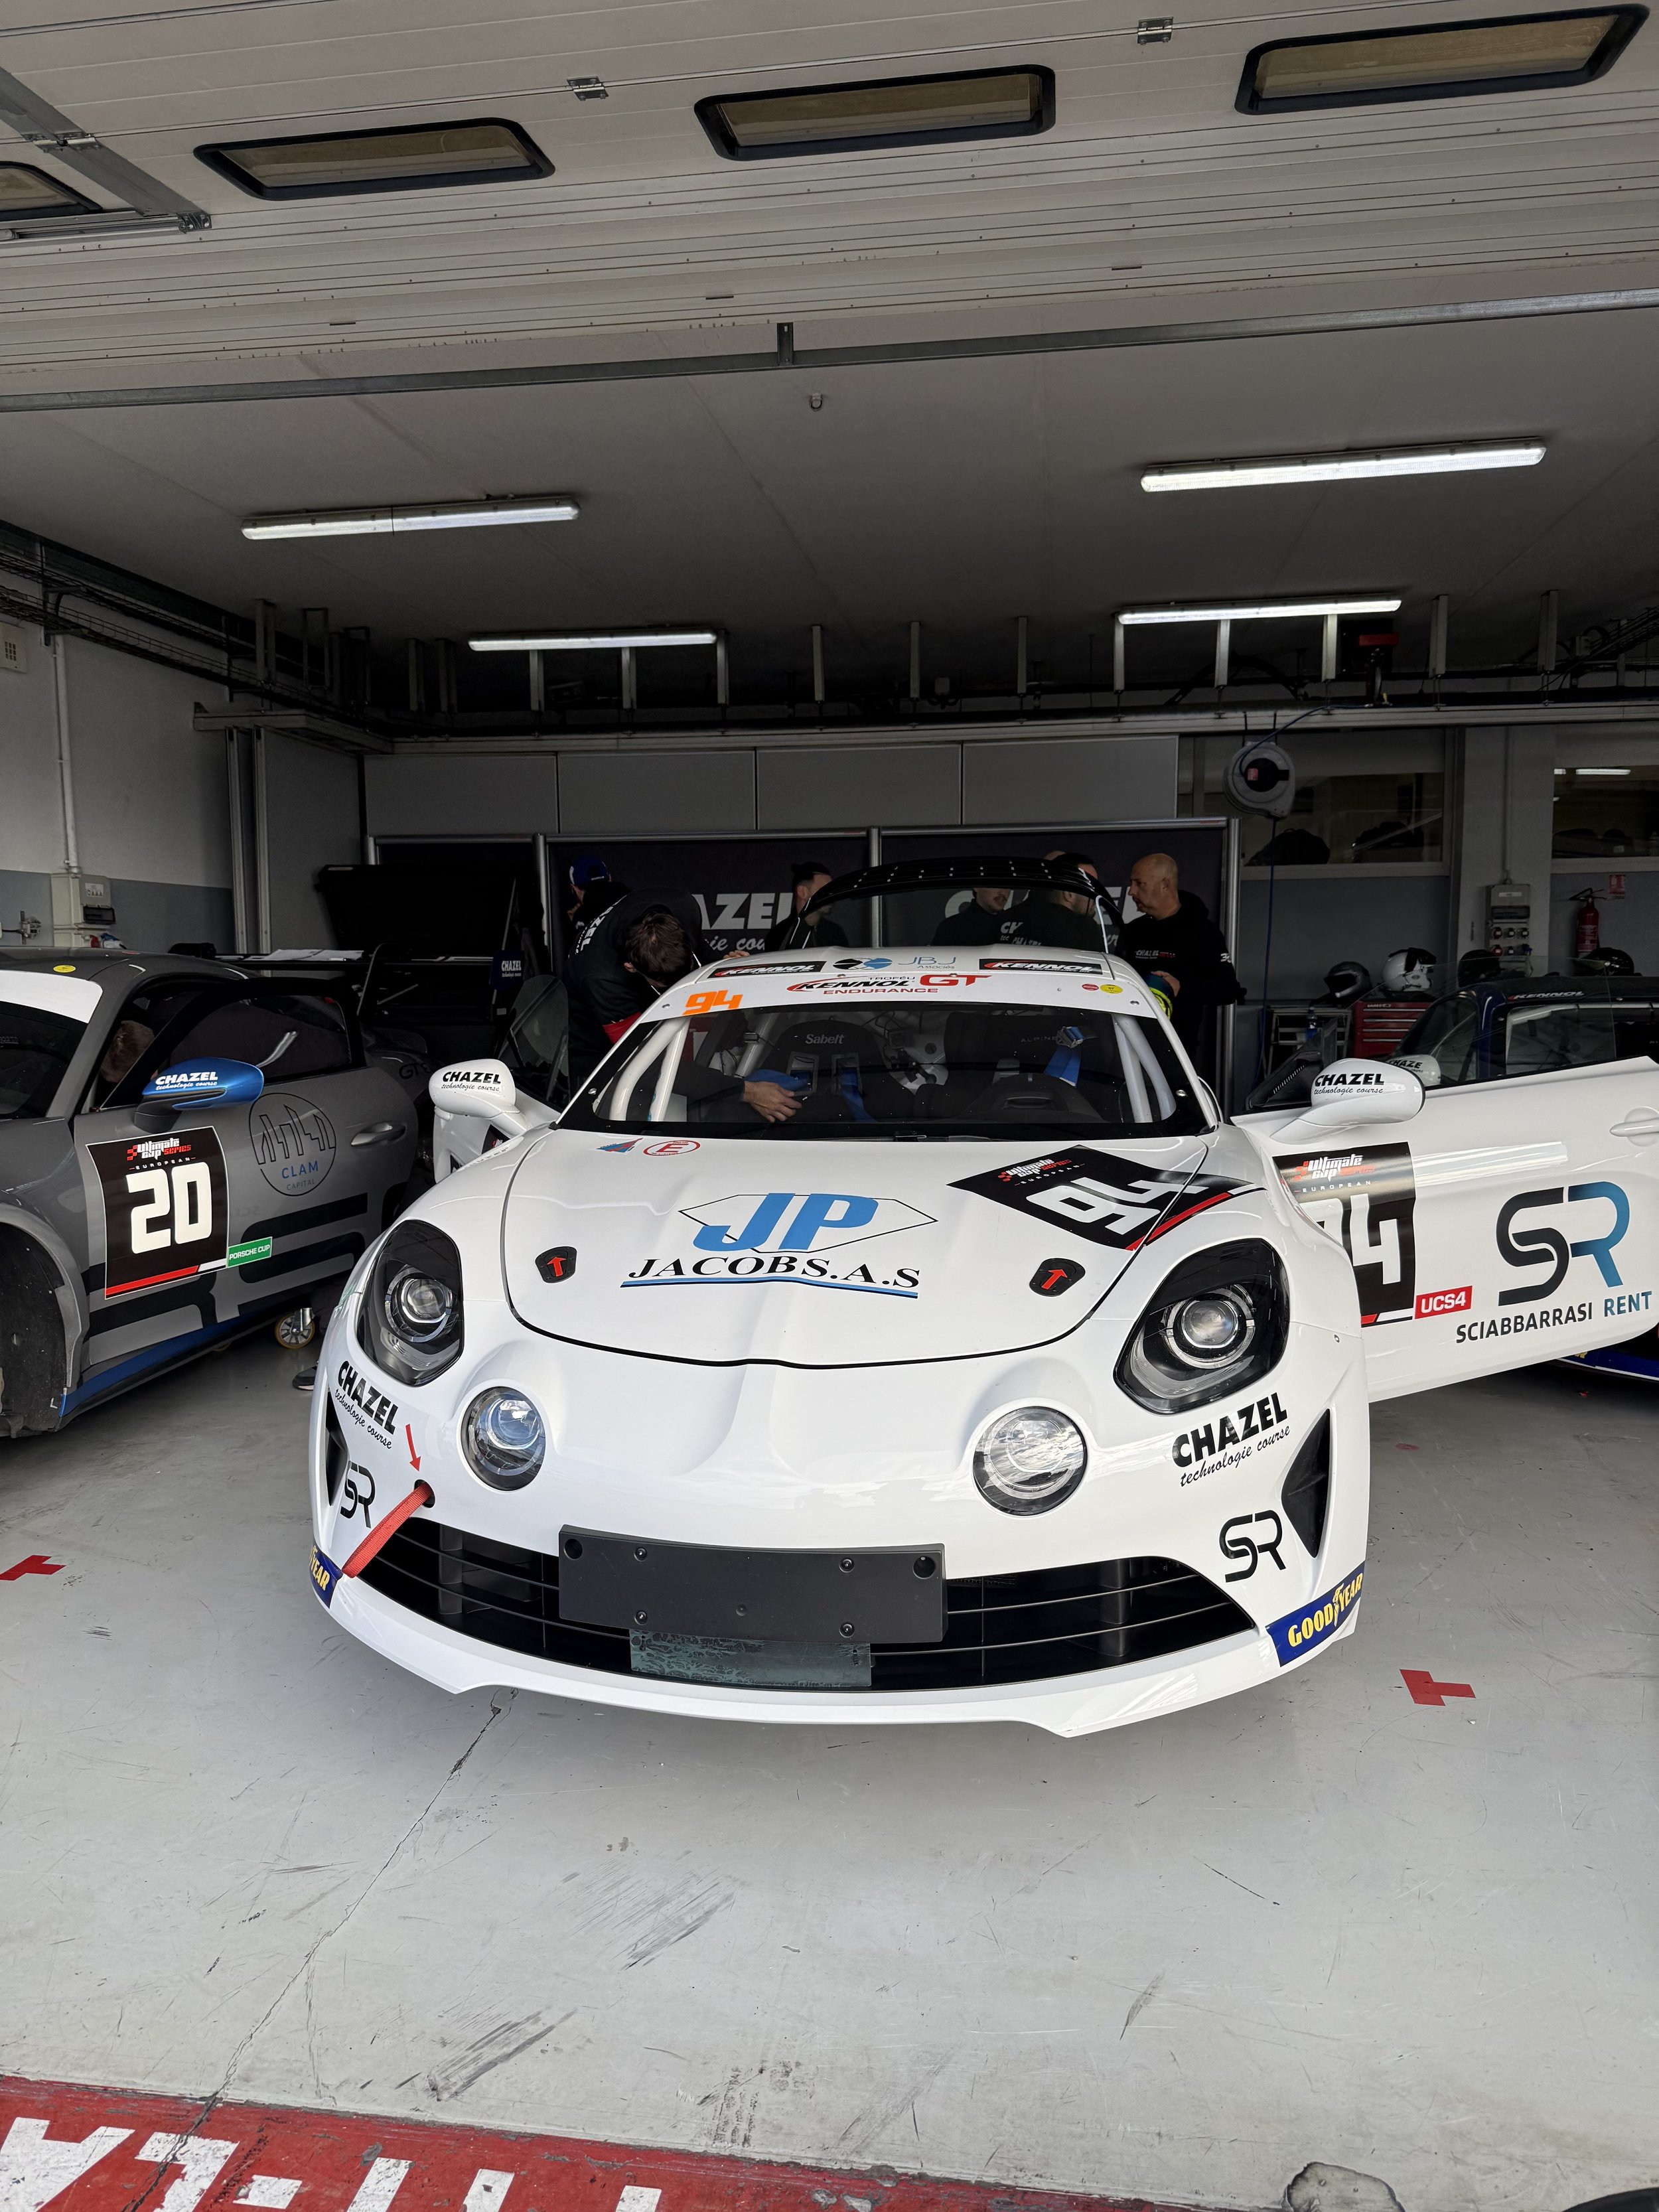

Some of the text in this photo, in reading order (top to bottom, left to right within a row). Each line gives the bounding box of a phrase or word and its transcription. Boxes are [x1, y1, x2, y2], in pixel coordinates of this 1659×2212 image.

[720, 964, 816, 975] KENNOL
[898, 956, 957, 966] JBJ
[991, 962, 1094, 972] KENNOL
[798, 974, 993, 990] KENNOL GT
[682, 989, 744, 1017] 94
[805, 1033, 845, 1044] Sabelt
[155, 1071, 218, 1085] CHAZEL
[442, 1071, 501, 1084] CHAZEL
[1315, 1073, 1385, 1086] CHAZEL
[155, 1082, 194, 1091] technologie
[441, 1082, 476, 1091] technologie
[1314, 1086, 1354, 1096] technologie
[135, 1157, 190, 1170] EUROPEAN
[281, 1160, 319, 1179] CLAM
[286, 1179, 316, 1191] CAPITAL
[1302, 1180, 1372, 1193] EUROPEAN
[125, 1161, 212, 1254] 20
[1025, 1176, 1210, 1235] 94
[693, 1193, 879, 1252] JP
[228, 1244, 271, 1260] PORSCHE CUP
[1496, 1181, 1630, 1307] SR
[1421, 1294, 1467, 1314] UCS4
[1455, 1290, 1652, 1344] SCIABBARRASI RENT
[338, 1361, 399, 1435] CHAZEL
[335, 1388, 392, 1449] technologie course
[1172, 1392, 1288, 1468] CHAZEL
[1180, 1425, 1291, 1487] technologie course
[340, 1460, 376, 1529] SR
[1219, 1509, 1287, 1583] SR
[1287, 1572, 1363, 1647] GOODYEAR
